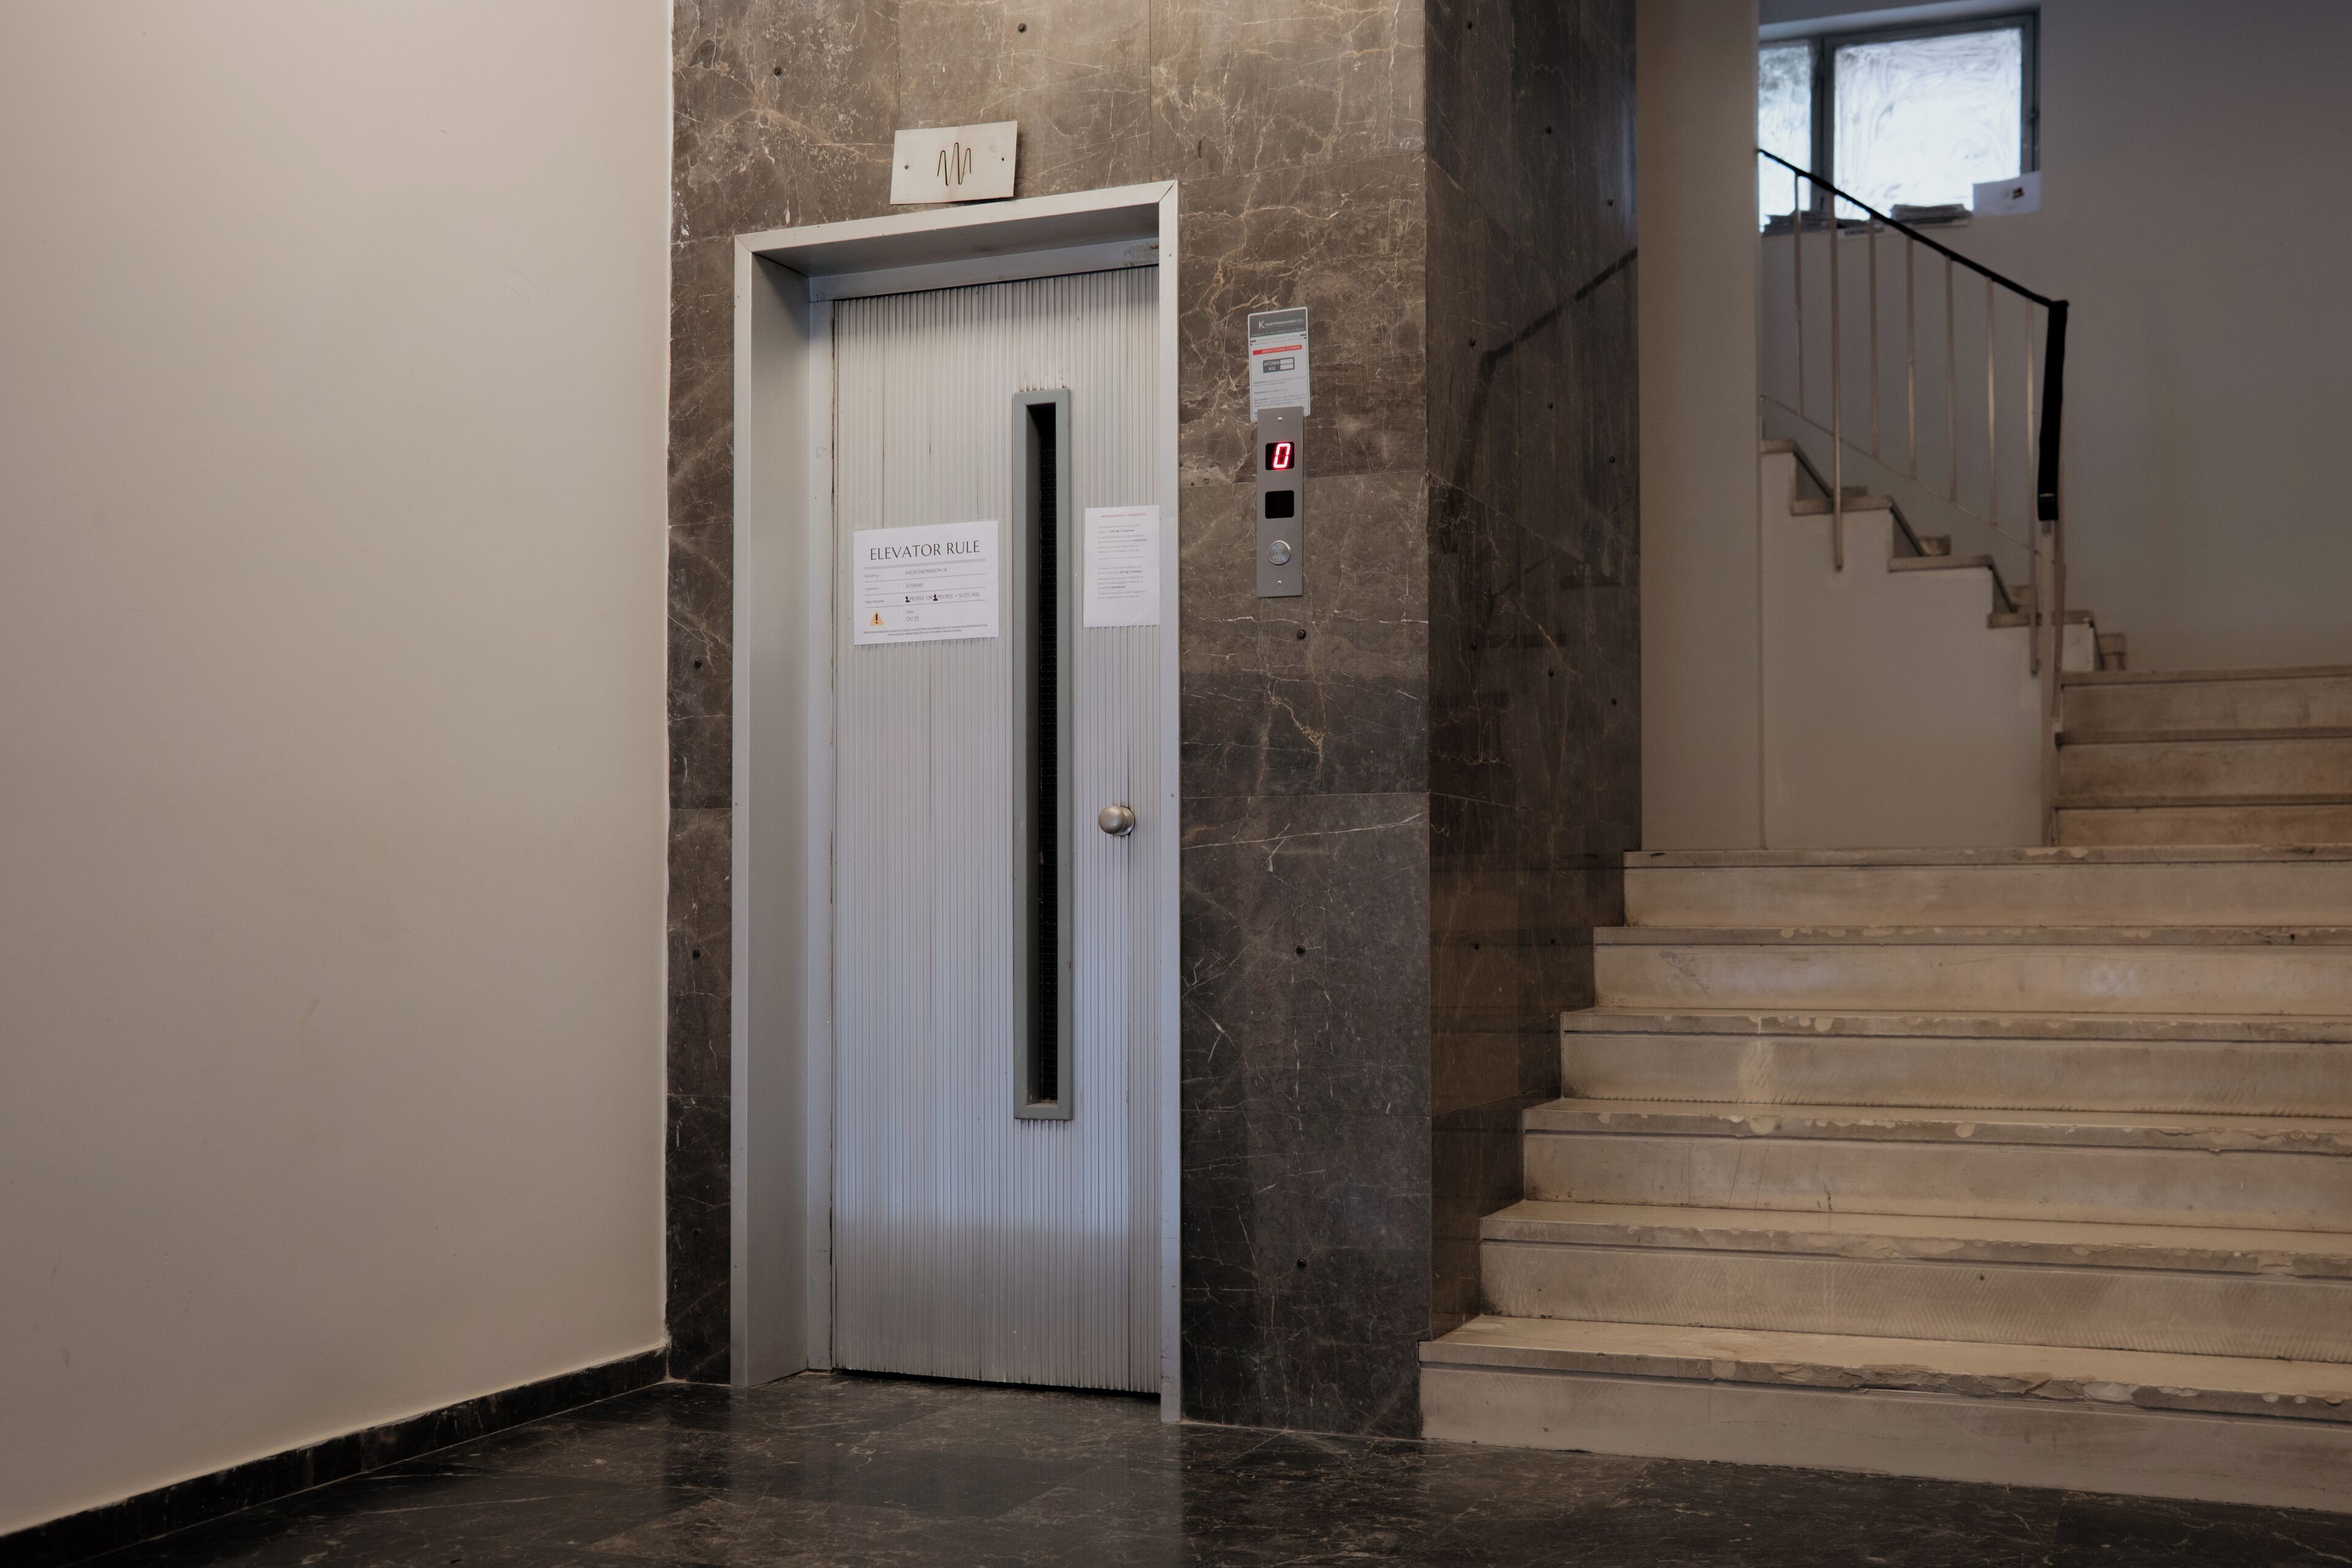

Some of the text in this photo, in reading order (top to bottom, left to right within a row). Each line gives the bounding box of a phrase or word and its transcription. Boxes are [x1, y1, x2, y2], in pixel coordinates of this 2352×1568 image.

[1273, 443, 1291, 469] 0
[870, 540, 980, 560] ELEVATOR RULE
